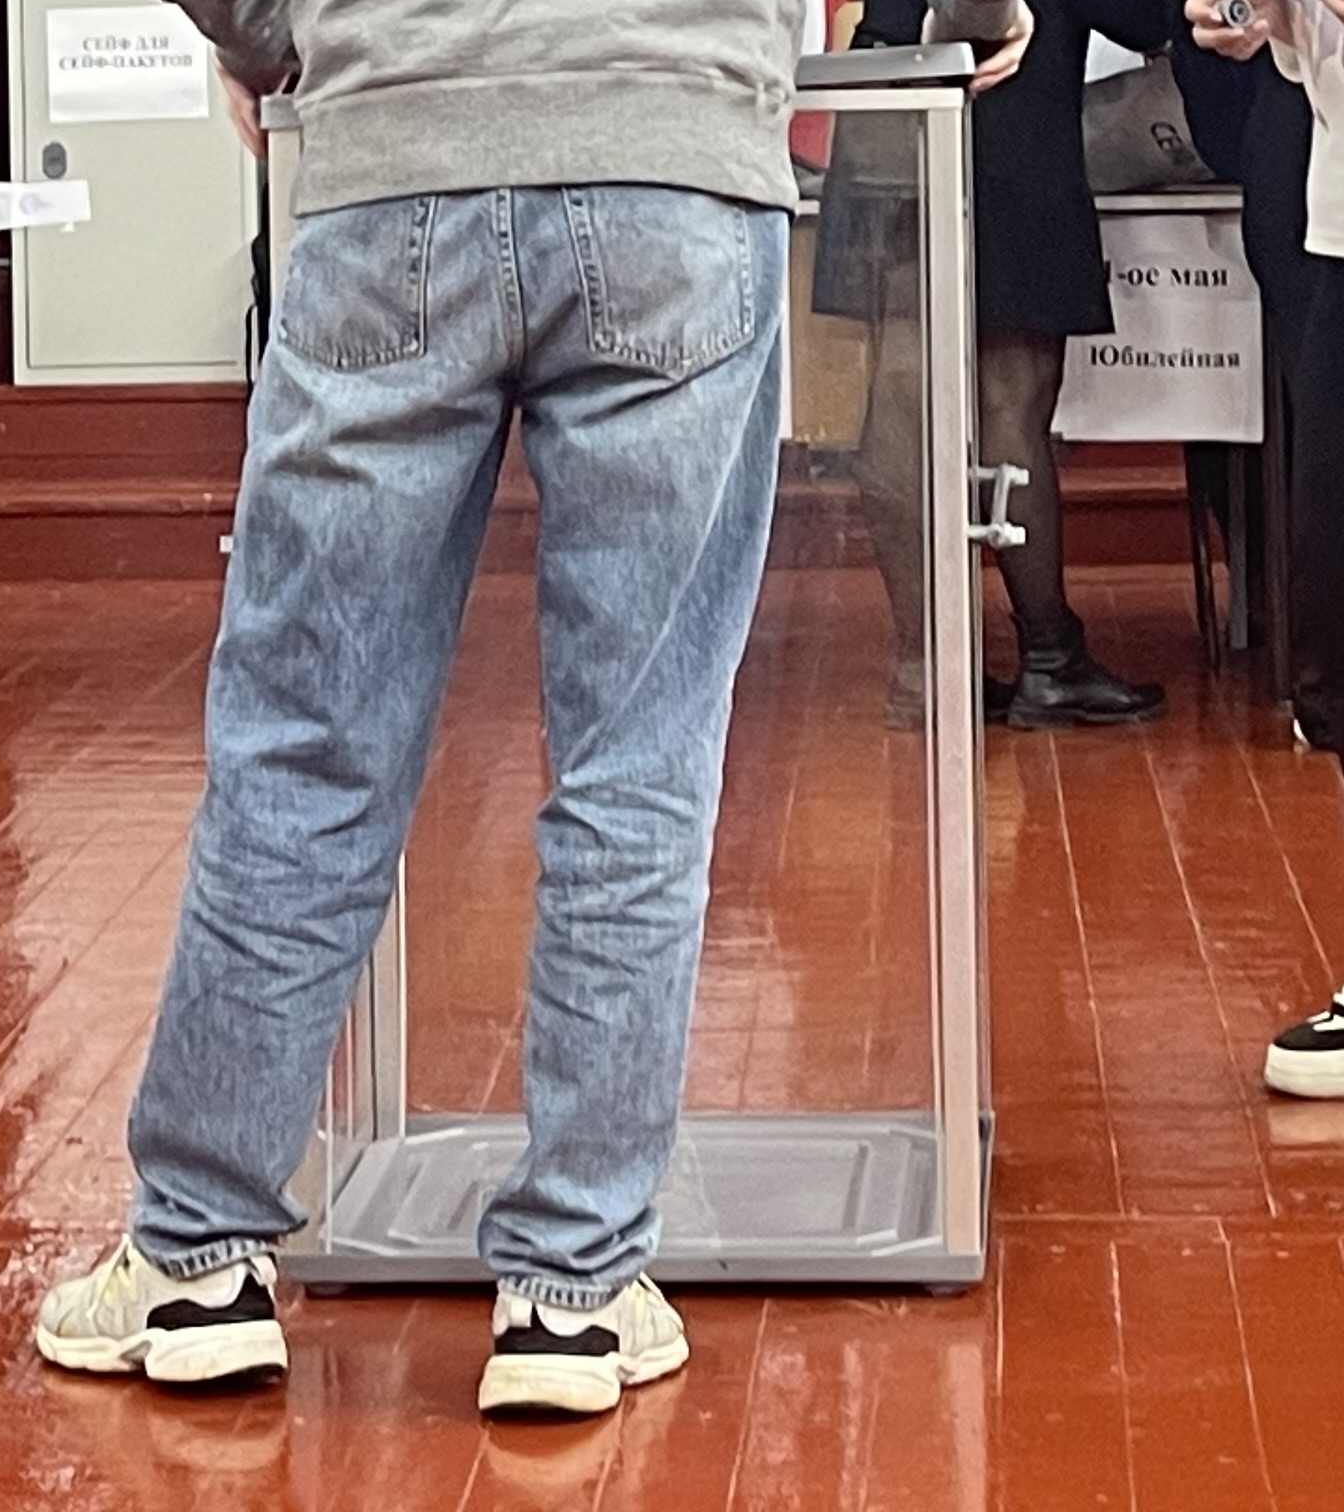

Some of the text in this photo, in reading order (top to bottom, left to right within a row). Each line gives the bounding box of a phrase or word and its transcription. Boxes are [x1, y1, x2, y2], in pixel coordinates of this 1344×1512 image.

[82, 36, 170, 52] СЕЙФ ДЛЯ
[58, 55, 193, 71] СЕЙФ-ПАКЕТОВ
[1170, 268, 1228, 287] мая
[1090, 344, 1241, 368] Юбилейная
